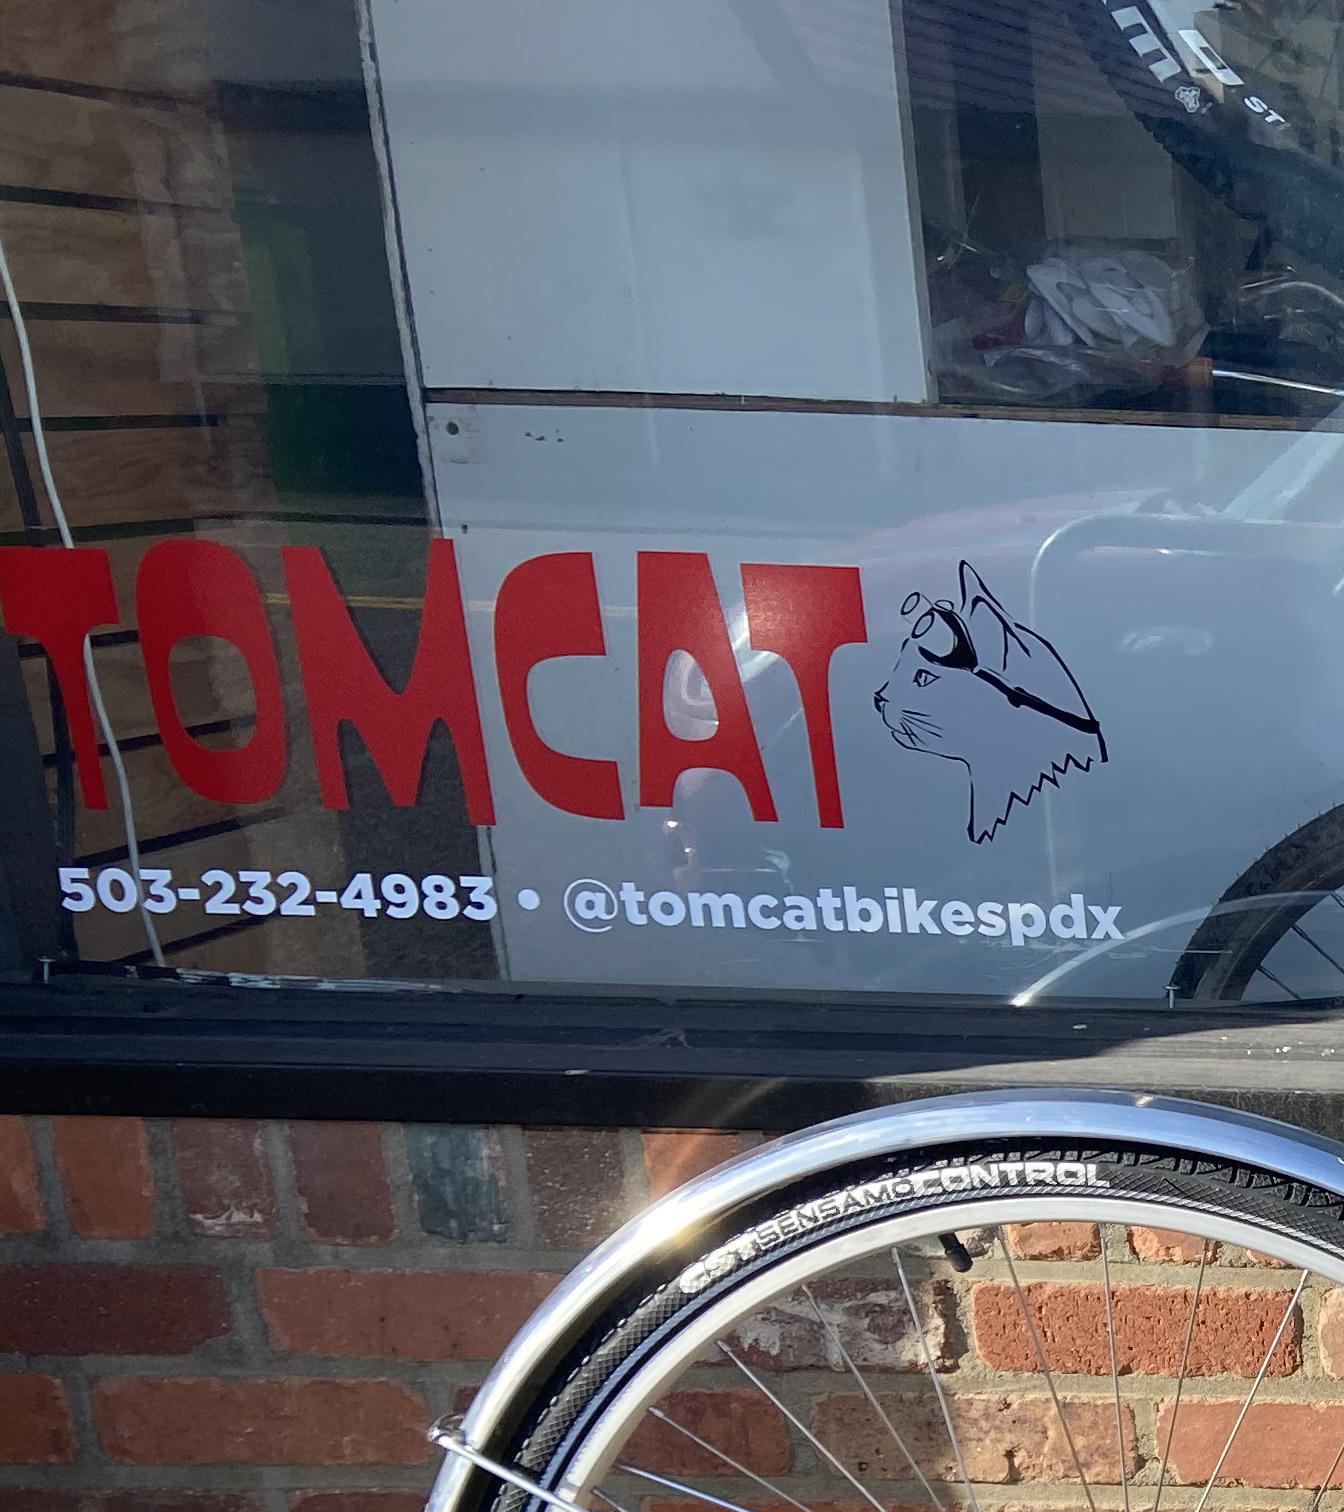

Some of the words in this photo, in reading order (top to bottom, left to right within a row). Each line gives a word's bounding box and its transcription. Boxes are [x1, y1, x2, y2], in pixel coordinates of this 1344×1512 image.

[0, 538, 869, 830] TOMCAT
[57, 867, 498, 922] 503-232-4983
[562, 877, 1124, 942] @tomcatbikespdx
